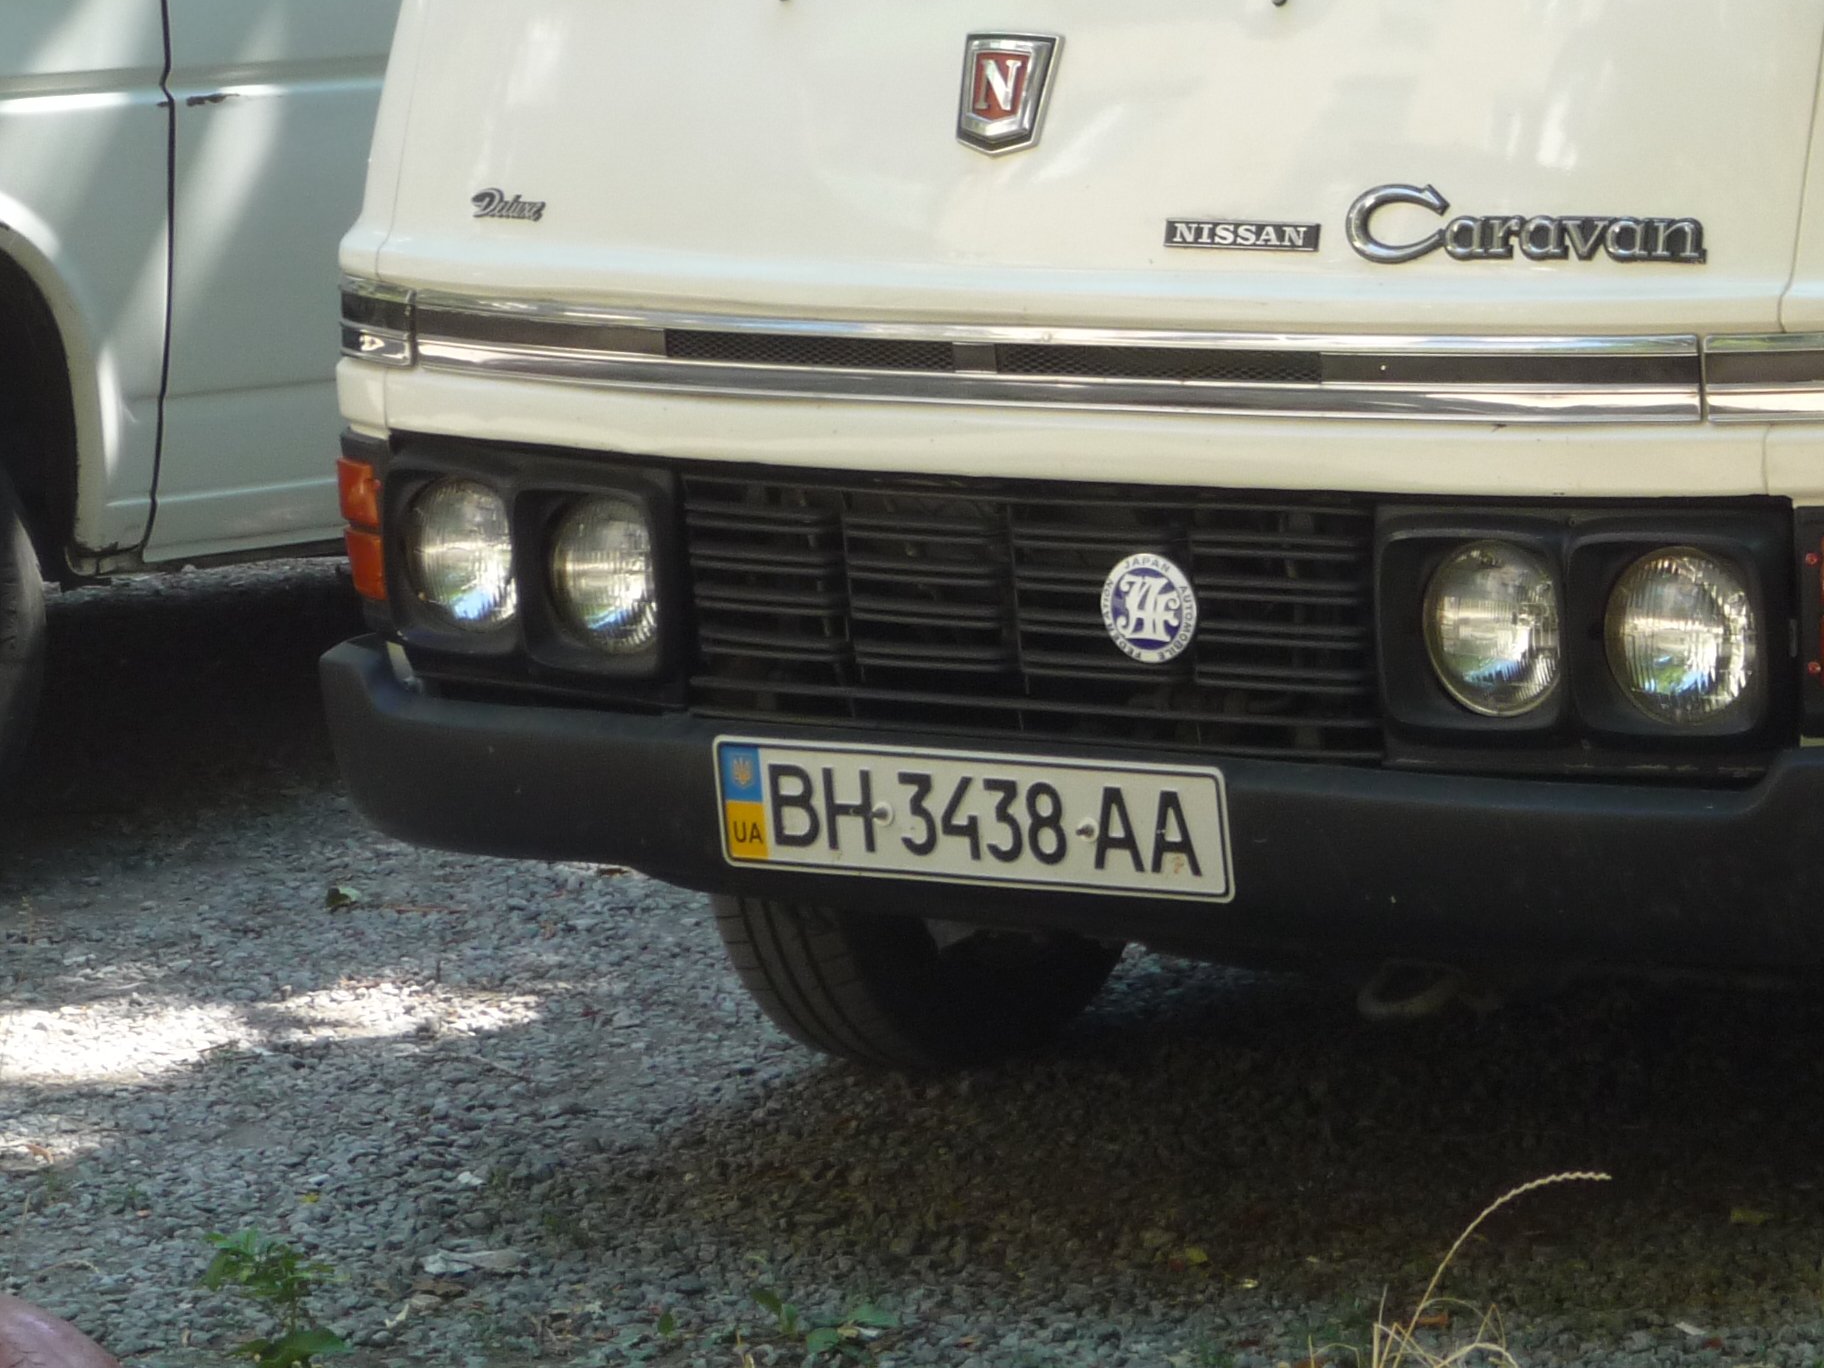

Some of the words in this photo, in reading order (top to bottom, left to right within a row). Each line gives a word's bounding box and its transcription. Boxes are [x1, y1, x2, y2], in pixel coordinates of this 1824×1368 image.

[974, 58, 1022, 111] N
[1171, 222, 1309, 247] NISSAN
[1345, 183, 1707, 264] Caravan
[1124, 557, 1171, 573] JAPAN
[1157, 585, 1194, 661] AUTOMOBILE
[733, 820, 764, 845] UA
[897, 772, 1068, 866] 3438
[1094, 785, 1203, 878] AA
